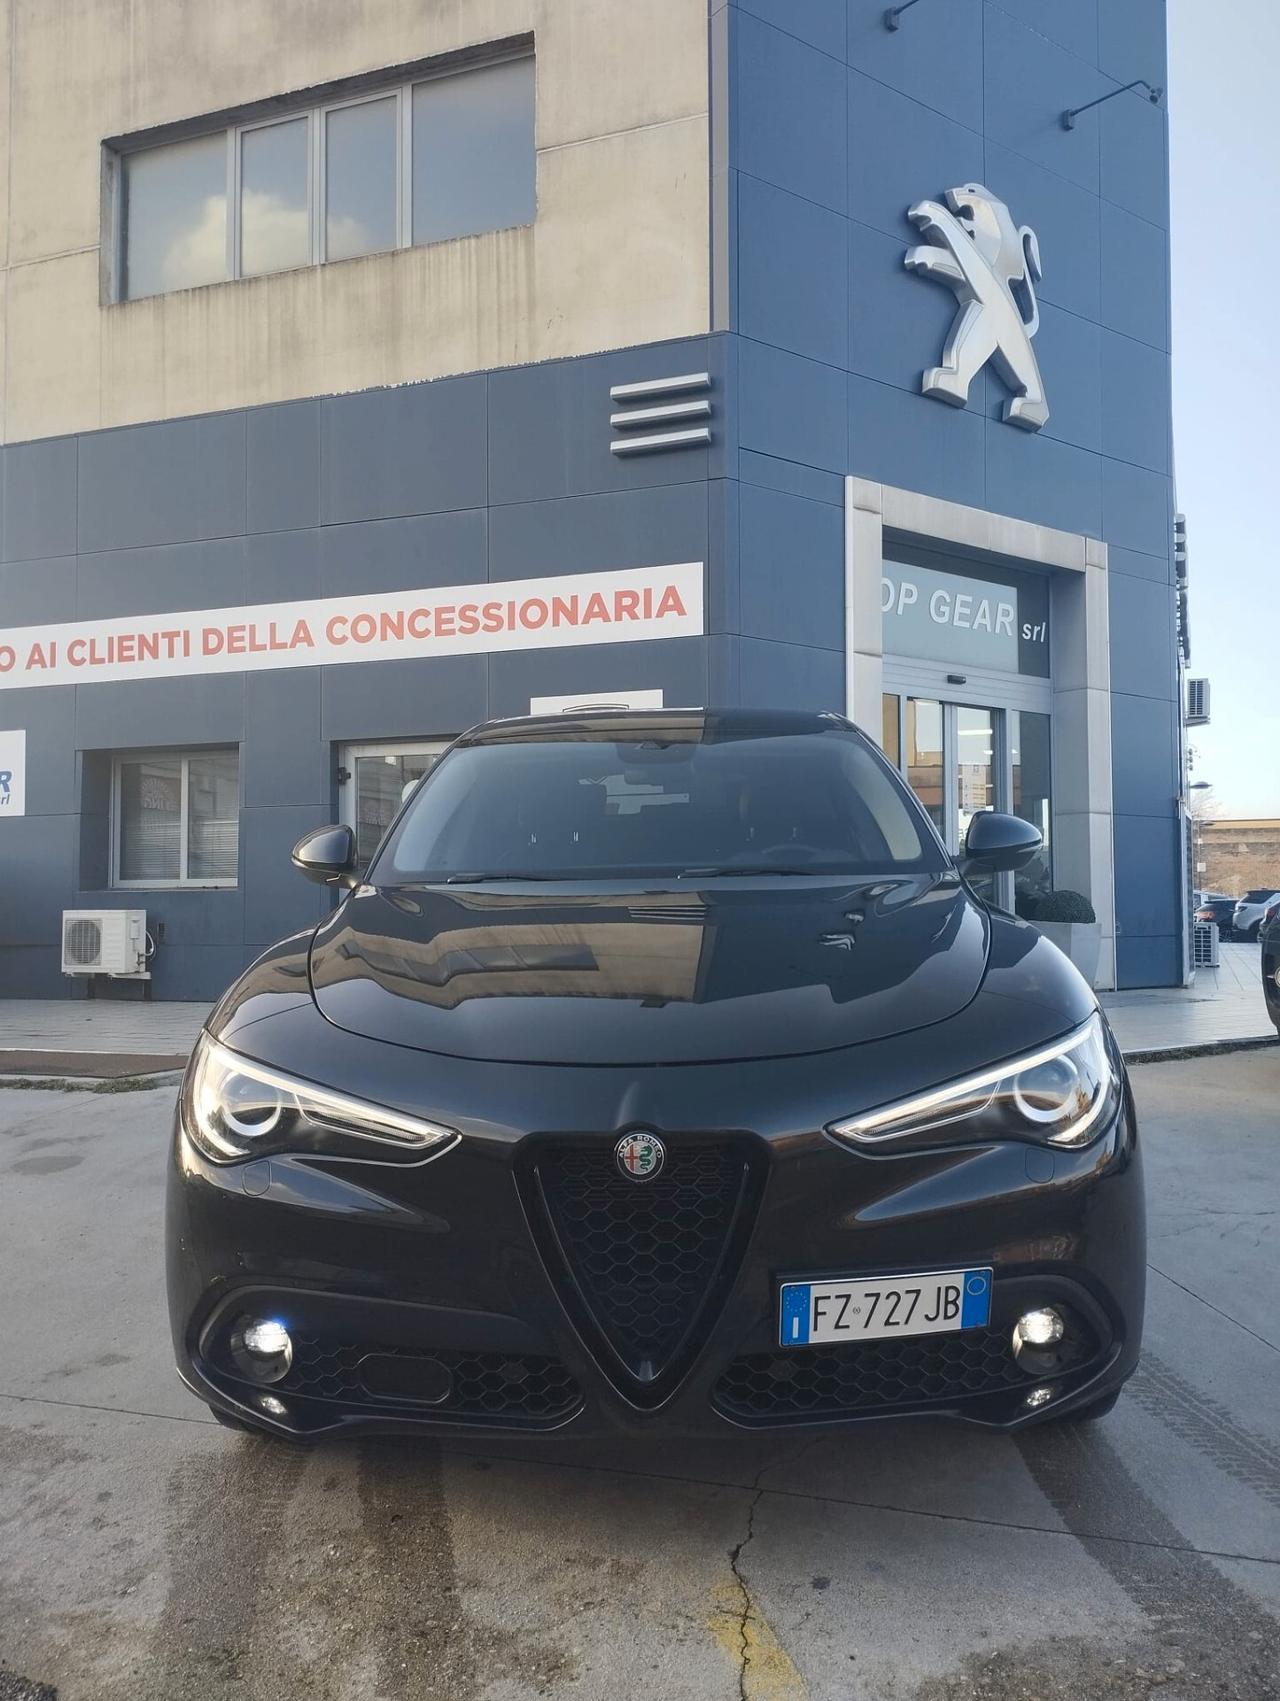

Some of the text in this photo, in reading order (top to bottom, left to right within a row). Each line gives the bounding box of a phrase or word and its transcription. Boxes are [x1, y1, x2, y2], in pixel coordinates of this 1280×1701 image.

[25, 642, 57, 670] AI
[67, 629, 190, 667] CLIENTI
[202, 619, 315, 656] DELLA
[325, 585, 688, 646] CONCESSIONARIA
[929, 589, 1015, 636] GEAR
[1022, 622, 1046, 643] srl
[619, 1135, 662, 1158] ALFA ROMEO
